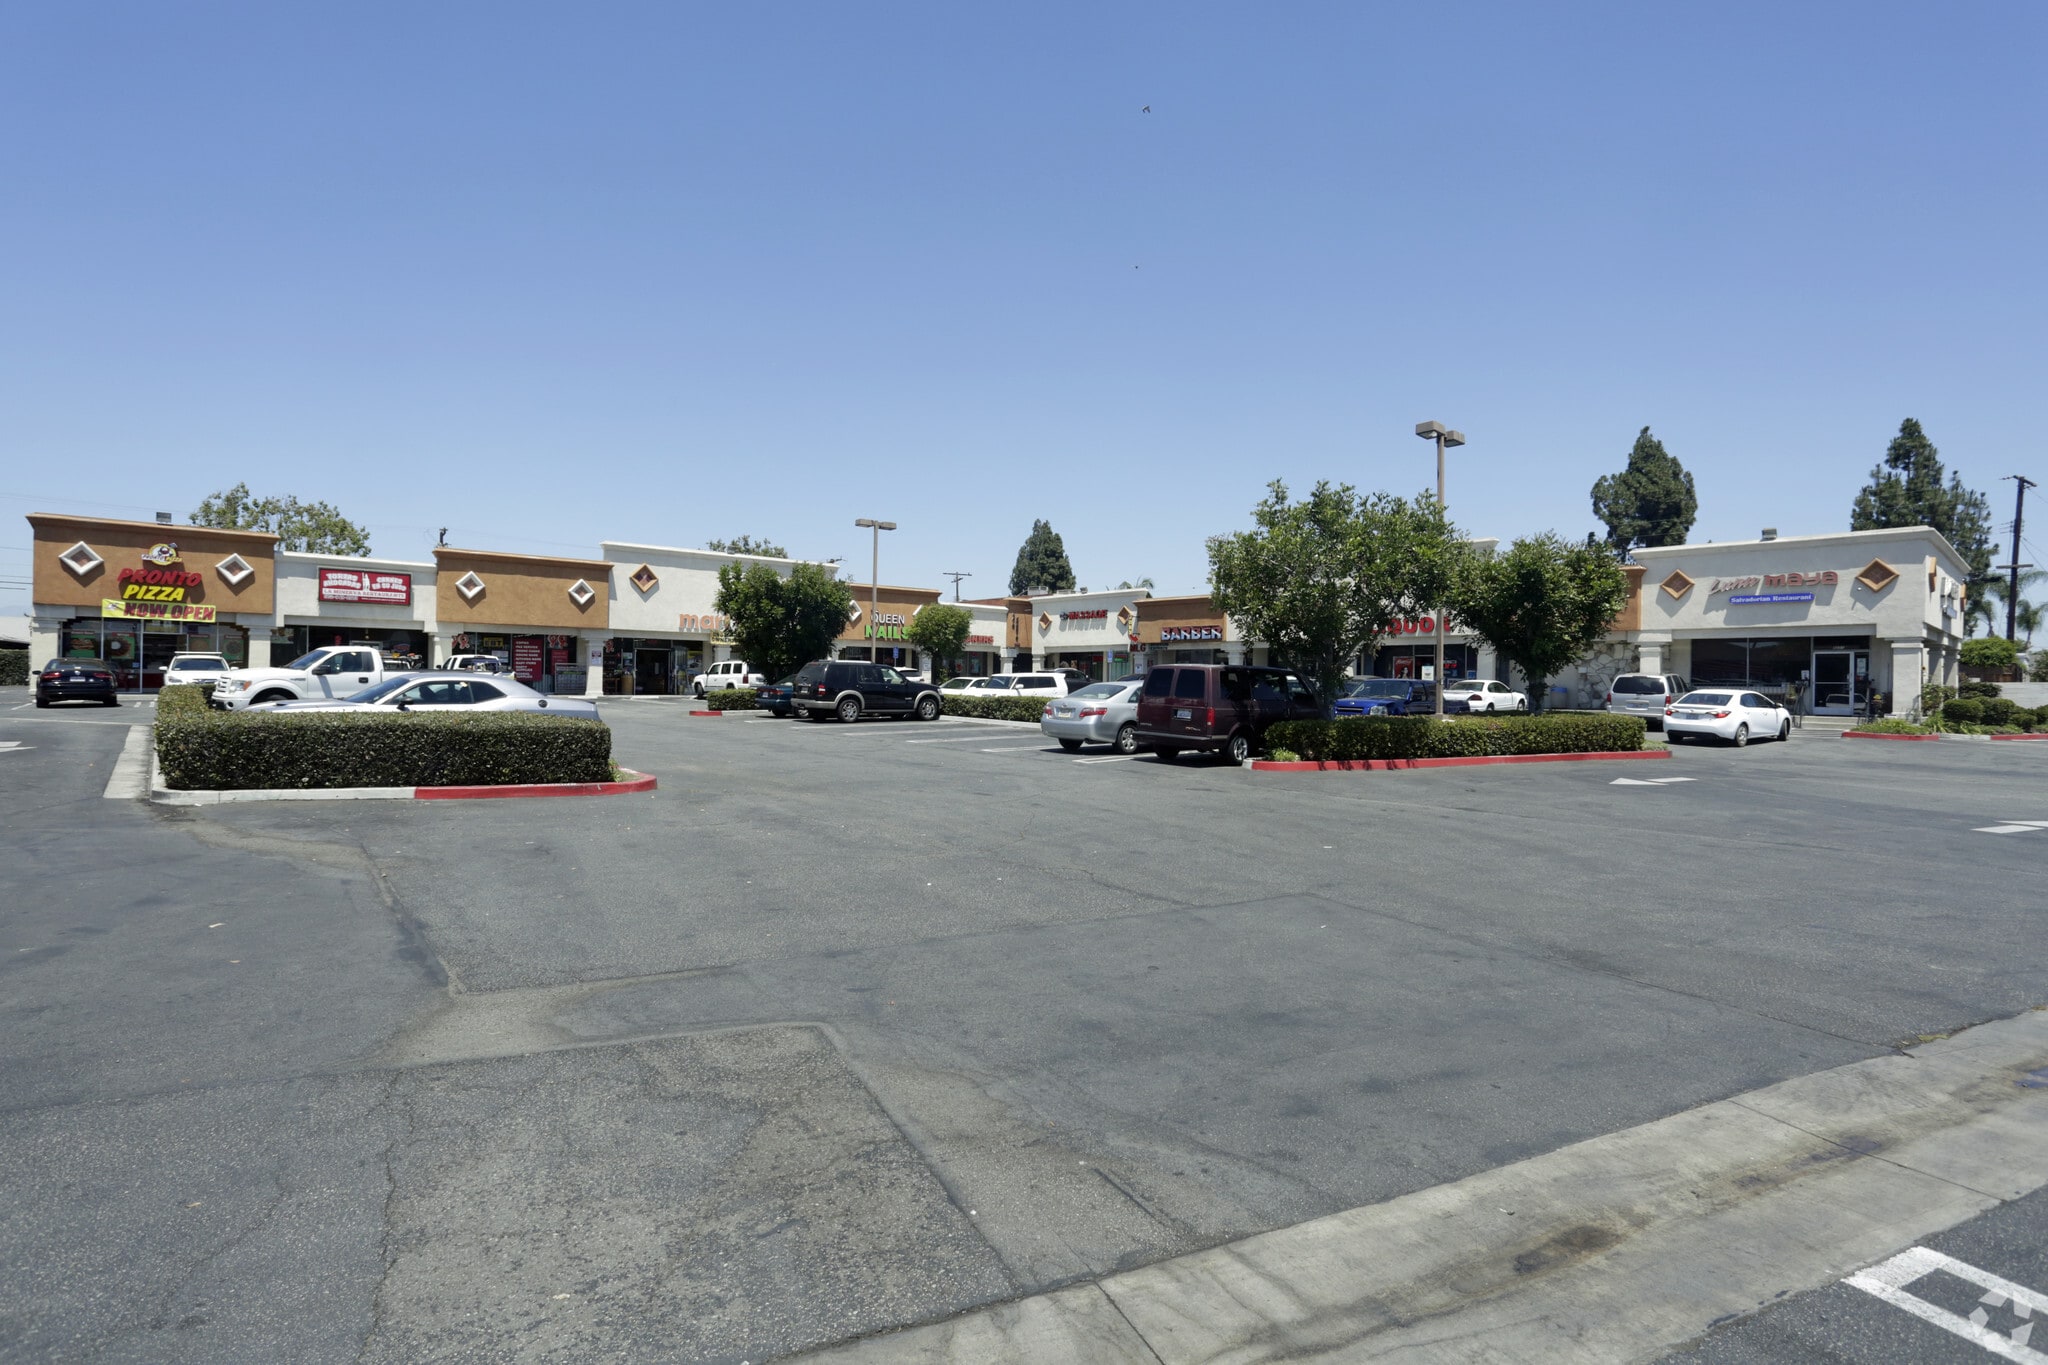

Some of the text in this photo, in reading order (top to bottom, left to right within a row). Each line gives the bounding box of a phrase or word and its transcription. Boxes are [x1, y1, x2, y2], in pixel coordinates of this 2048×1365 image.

[118, 568, 202, 586] PRONTO
[1764, 571, 1838, 587] maya
[123, 584, 185, 601] PIZZA
[1773, 593, 1812, 601] Restaurant
[124, 602, 214, 621] NOW OPEN
[873, 611, 905, 624] QUEEN
[1068, 609, 1108, 620] MASSAGE
[865, 625, 909, 639] NAILS
[1161, 625, 1222, 641] BARBER
[1371, 616, 1451, 635] QUO
